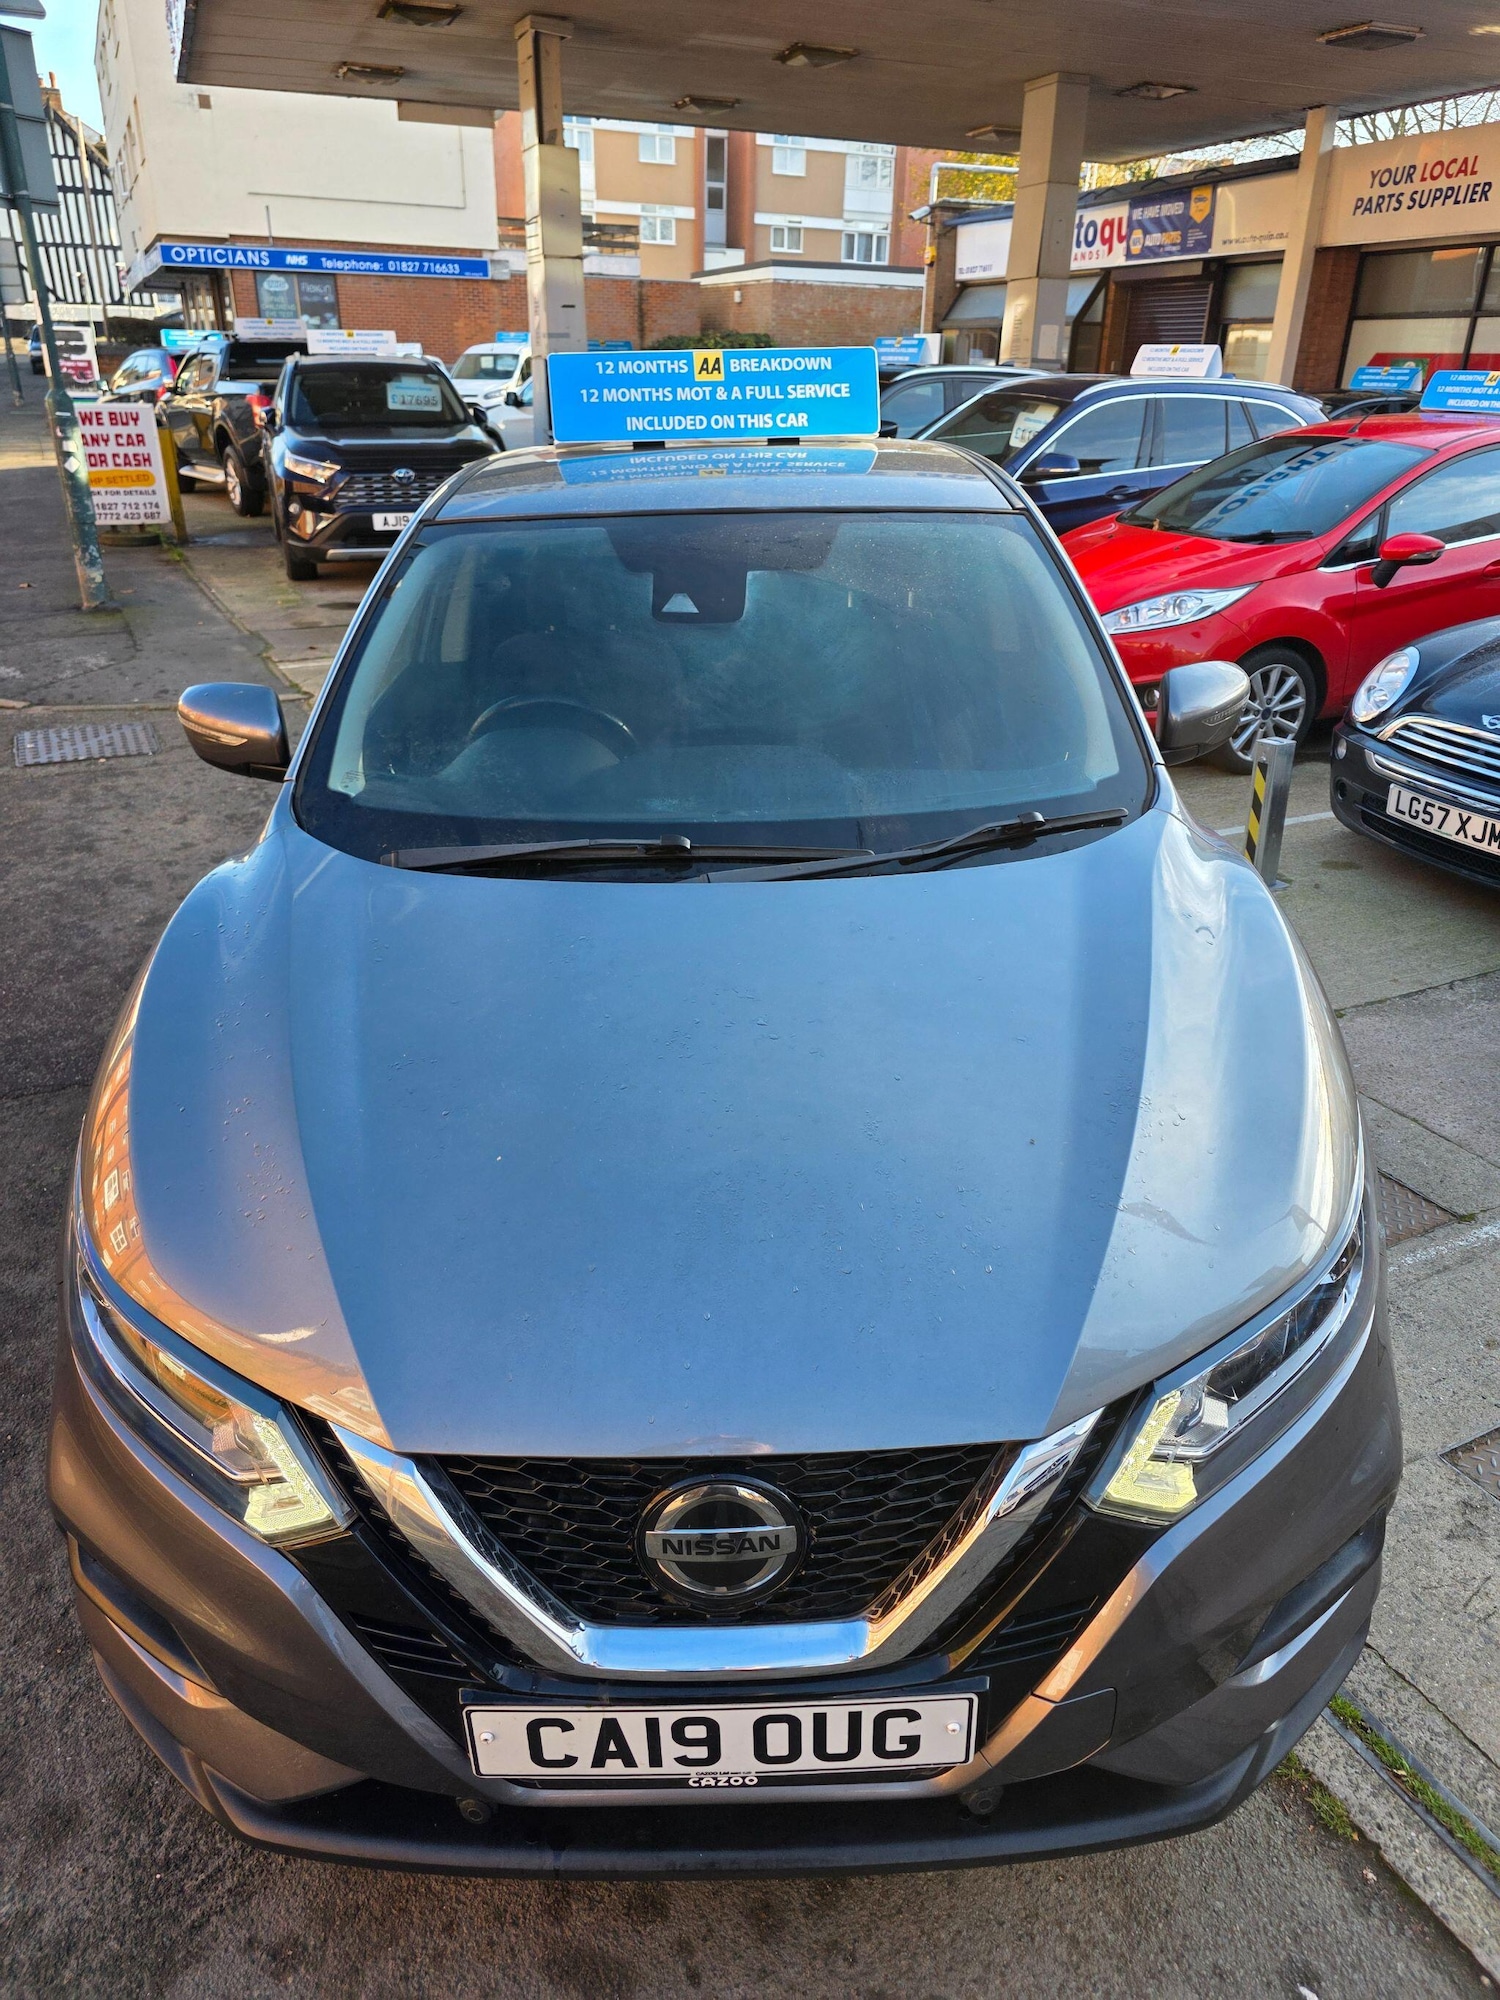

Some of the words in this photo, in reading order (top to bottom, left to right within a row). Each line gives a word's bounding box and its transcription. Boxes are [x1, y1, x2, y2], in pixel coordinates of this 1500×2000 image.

[1369, 164, 1417, 189] YOUR
[1419, 155, 1480, 183] LOCAL
[1352, 192, 1405, 216] PARTS
[1406, 181, 1493, 211] SUPPLIER
[171, 246, 270, 266] OPTICIANS
[286, 254, 308, 265] NHS
[320, 257, 383, 272] Telephone:
[388, 260, 420, 272] 01827
[595, 361, 615, 374] 12
[618, 359, 689, 374] MONTHS
[697, 357, 721, 375] AA
[729, 356, 832, 372] BREAKDOWN
[580, 388, 599, 403] 12
[603, 387, 673, 402] MONTHS
[676, 386, 713, 401] MOT
[715, 386, 728, 400] &
[731, 386, 742, 400] A
[745, 385, 784, 400] FULL
[787, 383, 850, 398] SERVICE
[78, 411, 104, 426] WE
[108, 411, 140, 426] BUY
[626, 415, 708, 431] INCLUDED
[710, 414, 735, 429] ON
[737, 413, 773, 429] THIS
[776, 412, 809, 428] CAR
[81, 433, 110, 447] ANY
[115, 433, 146, 447] CAR
[85, 453, 109, 467] OR
[112, 453, 152, 467] CASH
[106, 474, 150, 485] SETTLED
[96, 502, 118, 510] 1827
[121, 502, 140, 510] 712
[143, 502, 160, 510] 174
[97, 511, 121, 520] 7772
[123, 511, 141, 520] 423
[383, 515, 409, 527] AJ19
[1395, 790, 1451, 830] LG57
[662, 1534, 780, 1556] NISSAN
[526, 1716, 722, 1769] CA19
[753, 1708, 922, 1764] OUG
[688, 1776, 759, 1787] CAZOO
